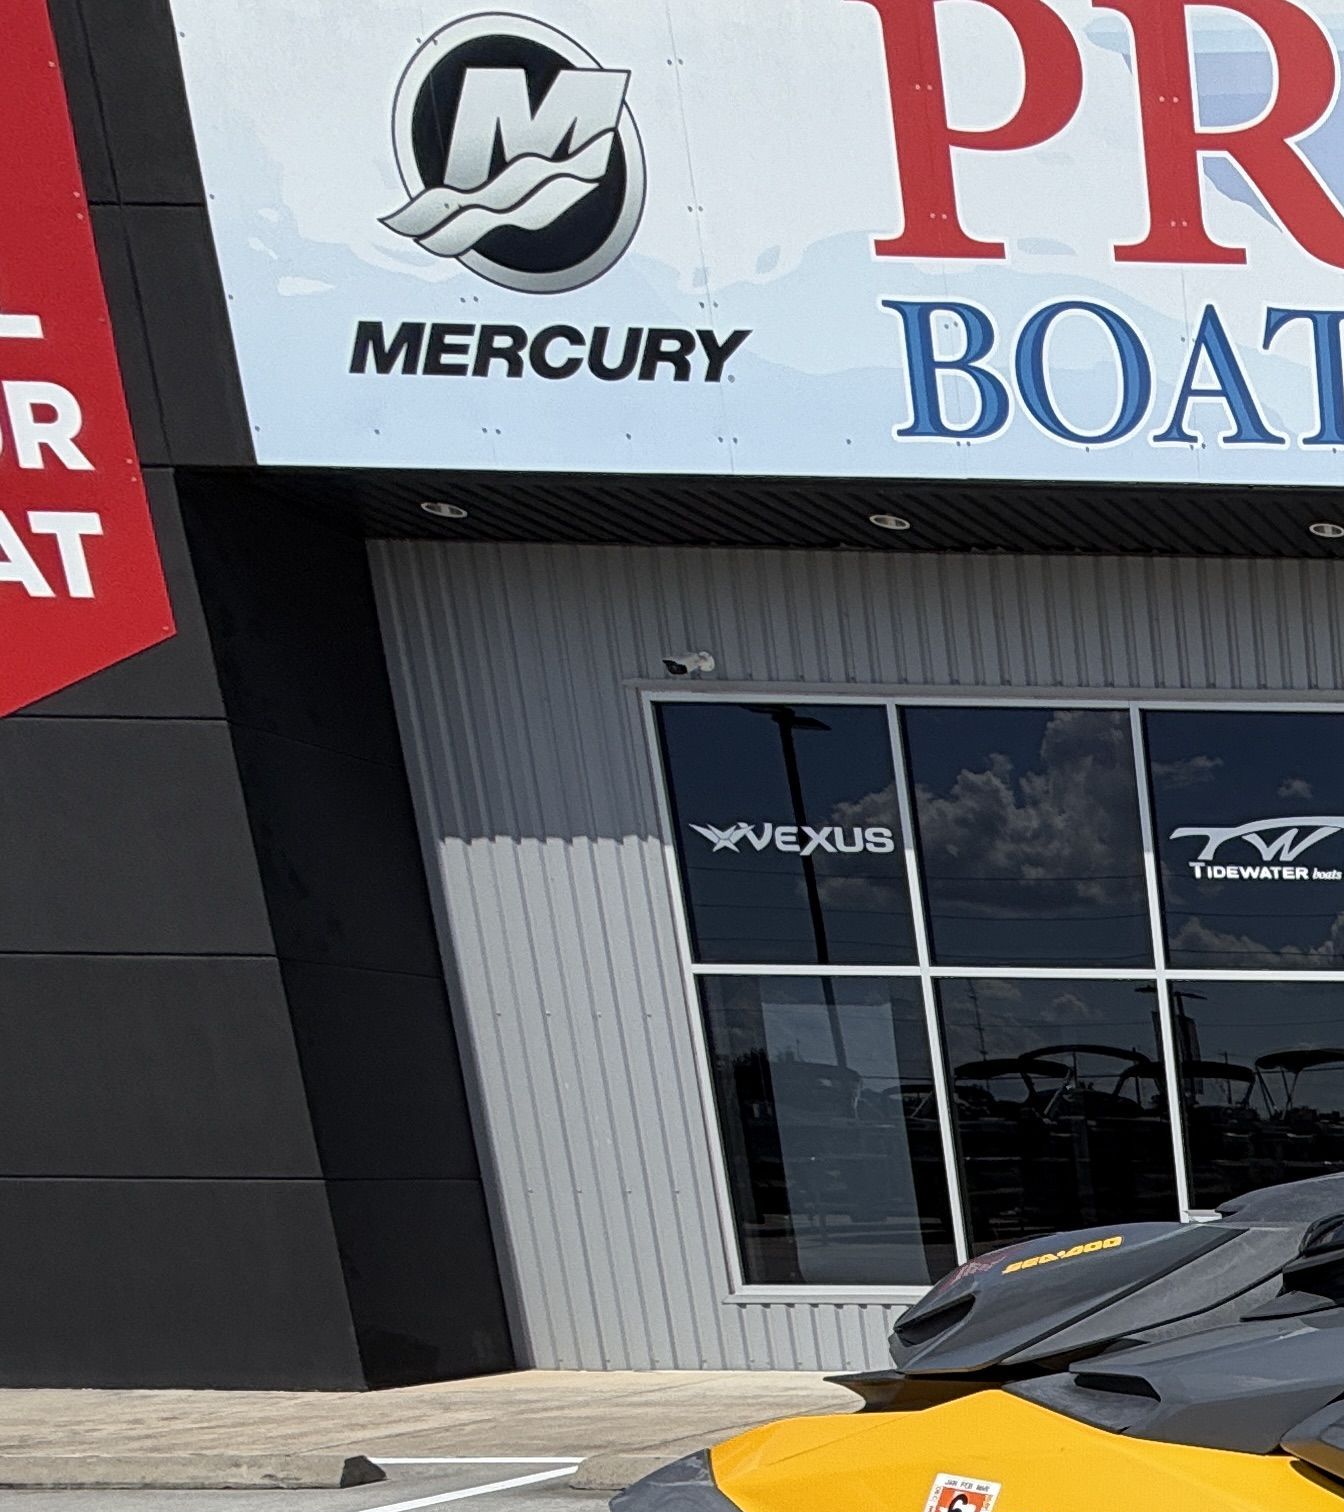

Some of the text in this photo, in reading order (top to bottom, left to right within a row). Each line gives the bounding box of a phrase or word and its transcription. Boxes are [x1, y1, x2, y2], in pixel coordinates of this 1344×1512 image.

[349, 320, 753, 383] MERCURY
[737, 822, 895, 857] VEXUS
[1188, 861, 1342, 881] TIDEWATER boats
